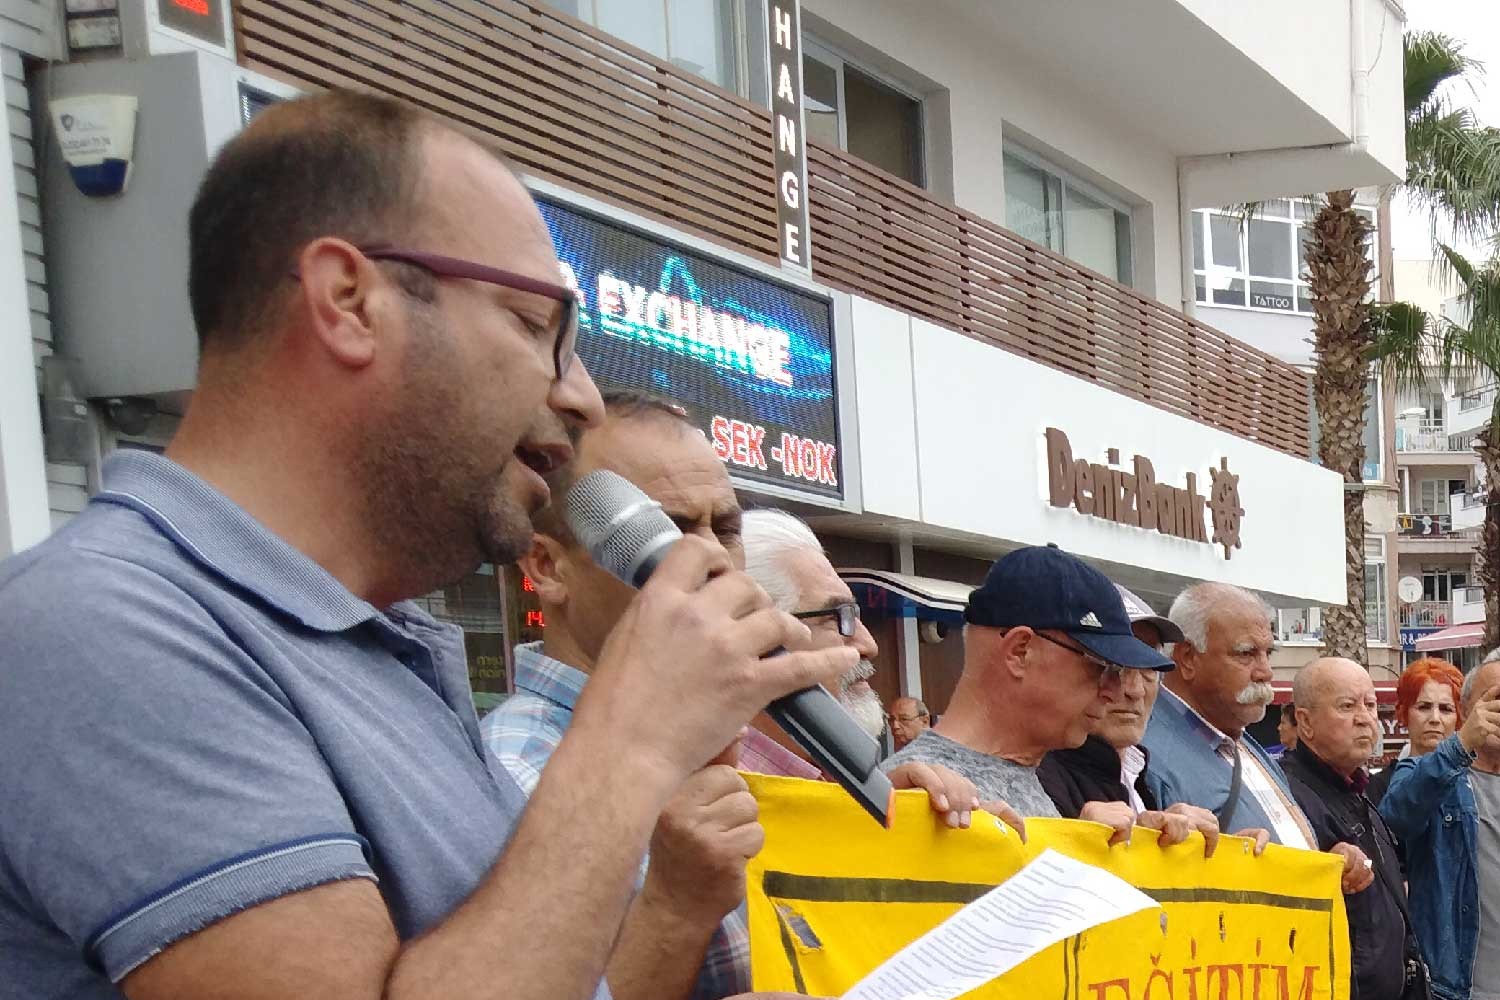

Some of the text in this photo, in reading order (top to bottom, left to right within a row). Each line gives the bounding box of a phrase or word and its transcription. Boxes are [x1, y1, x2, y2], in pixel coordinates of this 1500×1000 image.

[598, 272, 794, 388] EXCHANGE
[711, 415, 838, 487] SEK -NOK
[1045, 427, 1210, 544] DenizBank
